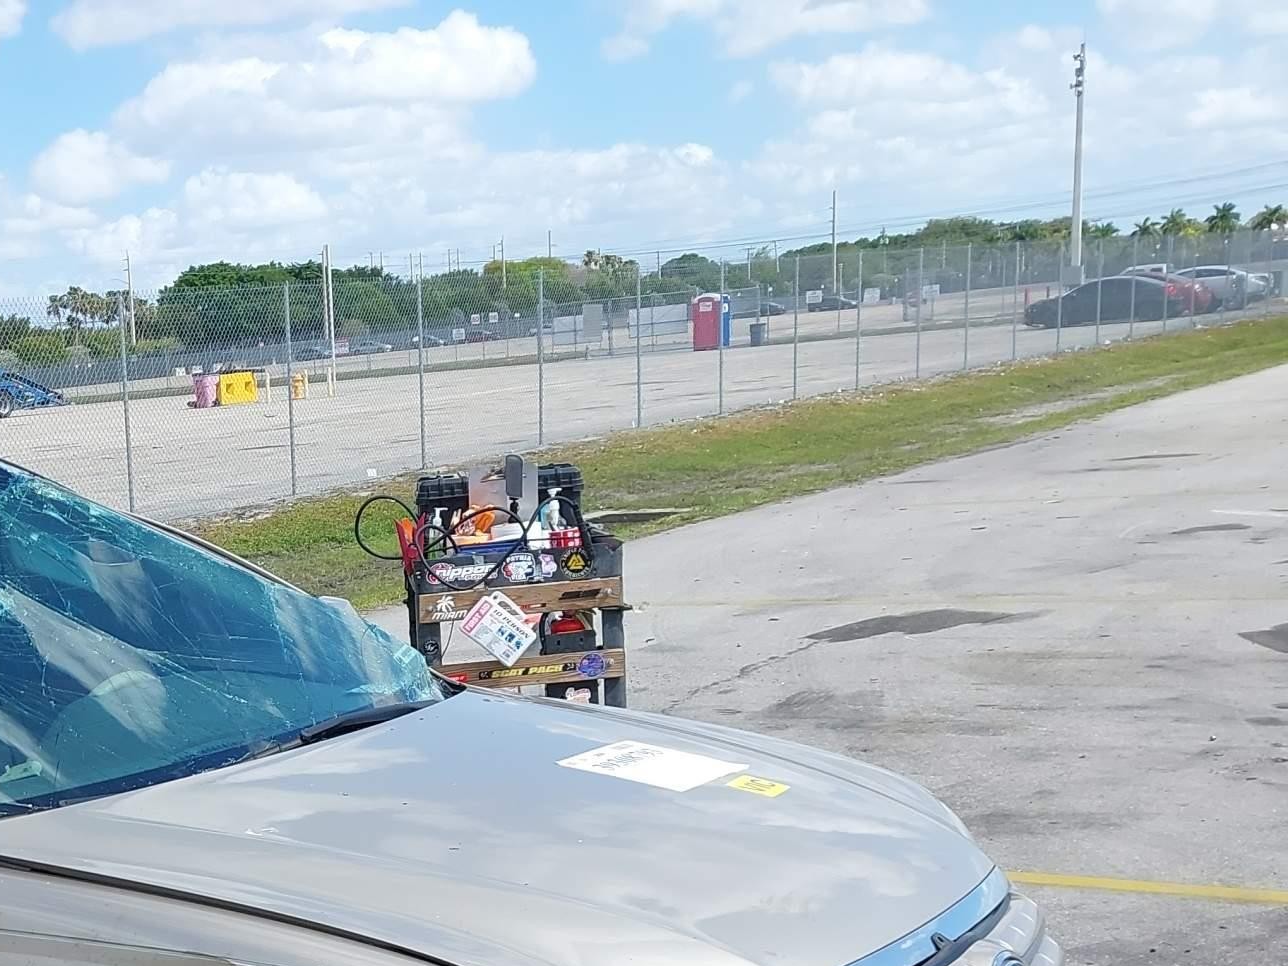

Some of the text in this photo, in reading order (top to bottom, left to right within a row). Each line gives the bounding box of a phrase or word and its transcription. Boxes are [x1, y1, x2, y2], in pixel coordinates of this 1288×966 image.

[432, 609, 468, 621] MIAM
[465, 602, 490, 632] FIRST AID
[502, 616, 531, 639] PERSON
